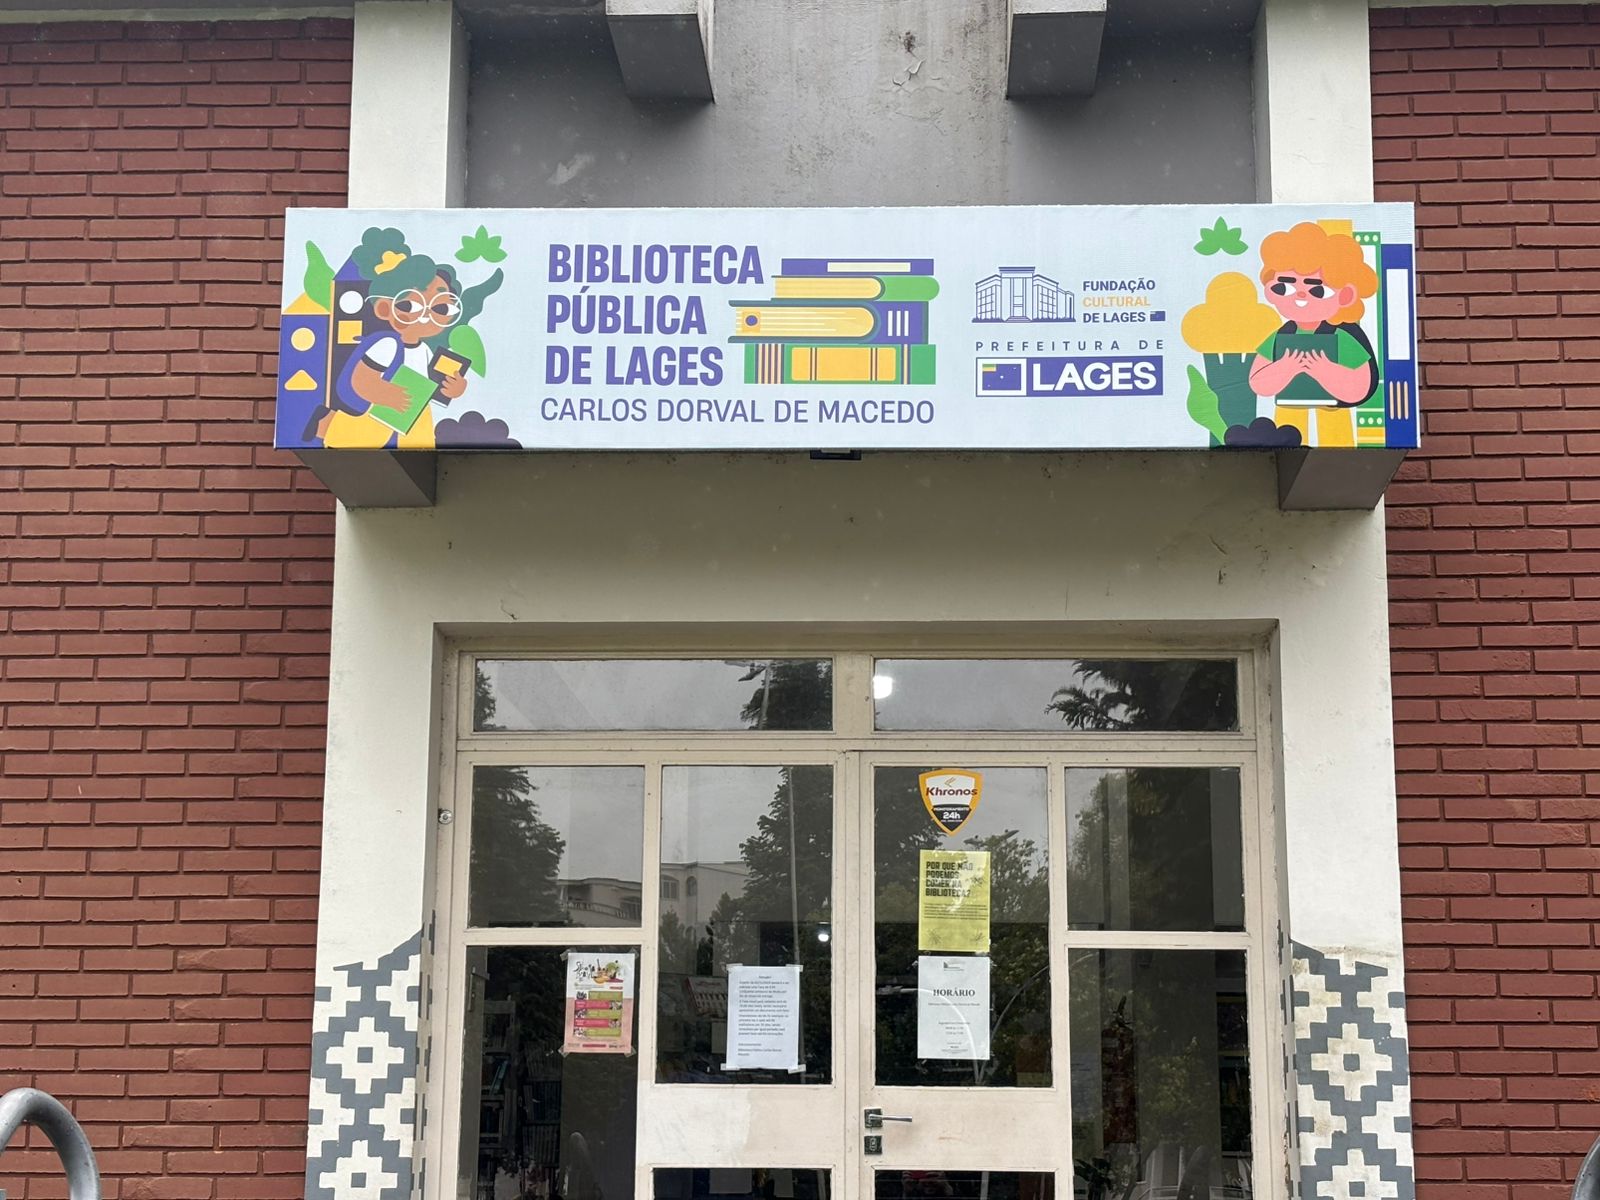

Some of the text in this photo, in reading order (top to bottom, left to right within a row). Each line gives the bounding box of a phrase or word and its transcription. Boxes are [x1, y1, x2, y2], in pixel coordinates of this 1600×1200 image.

[548, 244, 764, 285] BIBLIOTECA
[1083, 277, 1156, 293] FUNDAÇÃO
[1082, 296, 1152, 308] CULTURAL
[546, 286, 707, 335] PÚBLICA
[1083, 312, 1146, 323] DE LAGES
[975, 339, 1164, 351] PREFEITURA DE
[545, 345, 724, 386] DE LAGES
[1033, 361, 1157, 391] LAGES
[540, 397, 935, 424] CARLOS DORVAL DE MACEDO
[926, 786, 978, 796] Khronos
[943, 811, 961, 819] 24h
[926, 860, 973, 870] POR QUE NÃO
[926, 870, 960, 879] PODEMOS
[925, 879, 950, 887] COMER
[925, 887, 971, 897] BIBLIOTECA?
[933, 987, 975, 997] HORÁRIO
